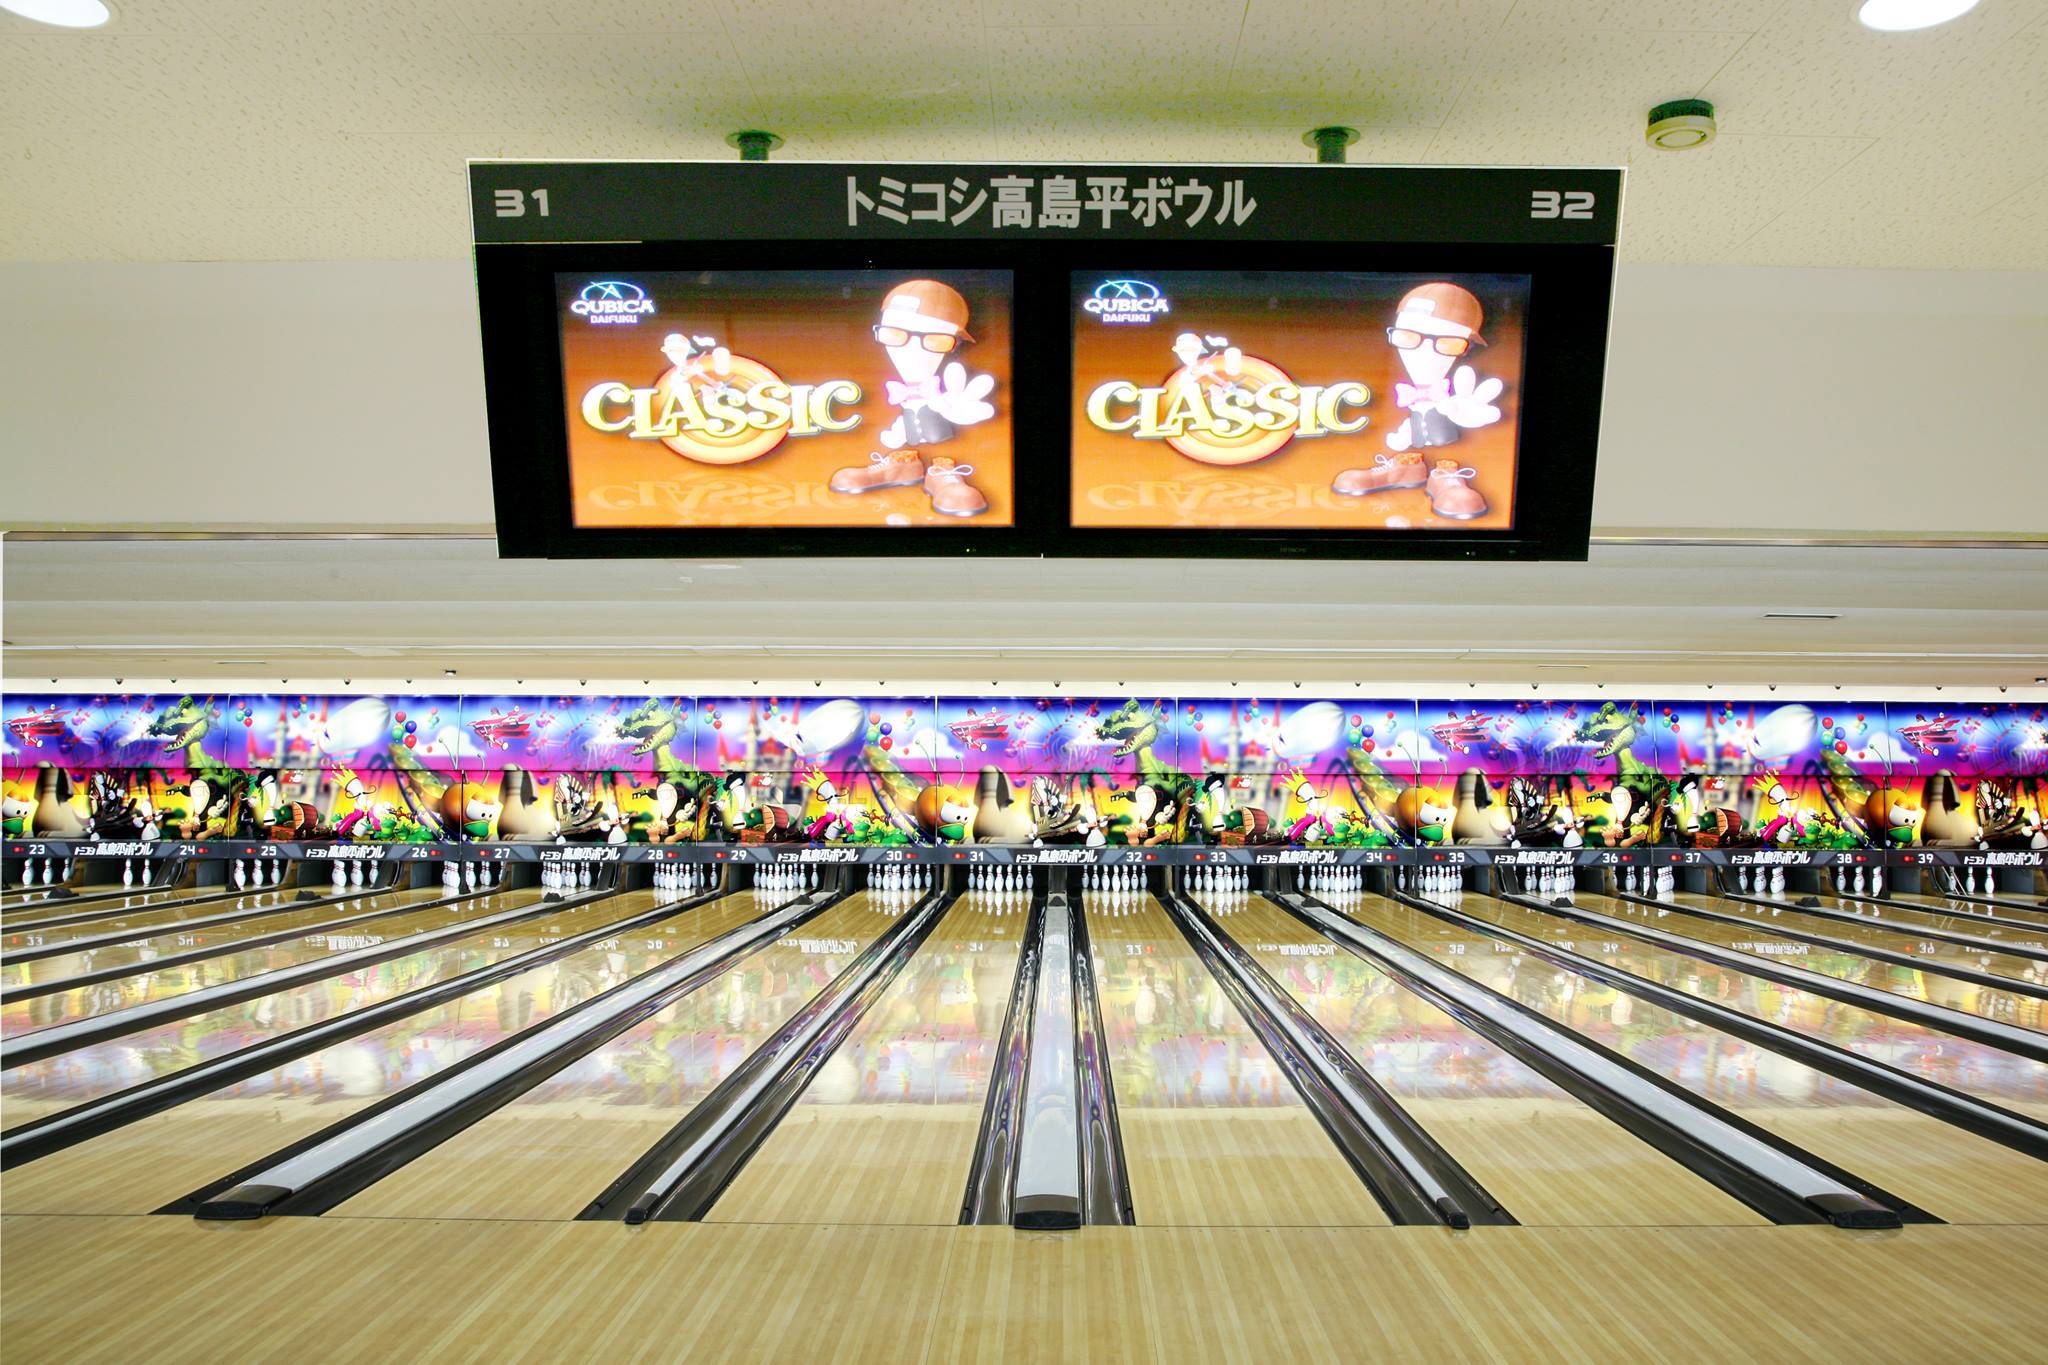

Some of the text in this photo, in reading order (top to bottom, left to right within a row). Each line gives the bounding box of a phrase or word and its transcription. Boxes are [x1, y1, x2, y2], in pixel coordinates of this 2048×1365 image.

[494, 188, 549, 217] 31
[847, 174, 1258, 229] トミコシ高島平ボウル
[1530, 190, 1595, 219] 32
[570, 299, 656, 315] QUBICA
[1083, 298, 1169, 313] QUBICA
[590, 314, 638, 324] DAIFUKU
[1102, 313, 1151, 323] DAIFUKU
[582, 379, 863, 439] CLASSIC
[1086, 381, 1370, 439] CLASSIC
[28, 844, 46, 855] 23
[179, 844, 196, 856] 24
[260, 845, 277, 857] 25
[411, 847, 428, 858] 26
[494, 847, 511, 859] 27
[648, 848, 664, 859] 28
[730, 849, 748, 861] 29
[886, 849, 903, 862] 30
[969, 850, 984, 862] 31
[1126, 851, 1143, 863] 32
[1210, 851, 1227, 863] 33
[1365, 851, 1382, 863] 34
[1448, 851, 1466, 864] 35
[1602, 852, 1619, 864] 36
[1685, 852, 1702, 864] 37
[1836, 853, 1853, 864] 38
[1918, 853, 1934, 864] 39
